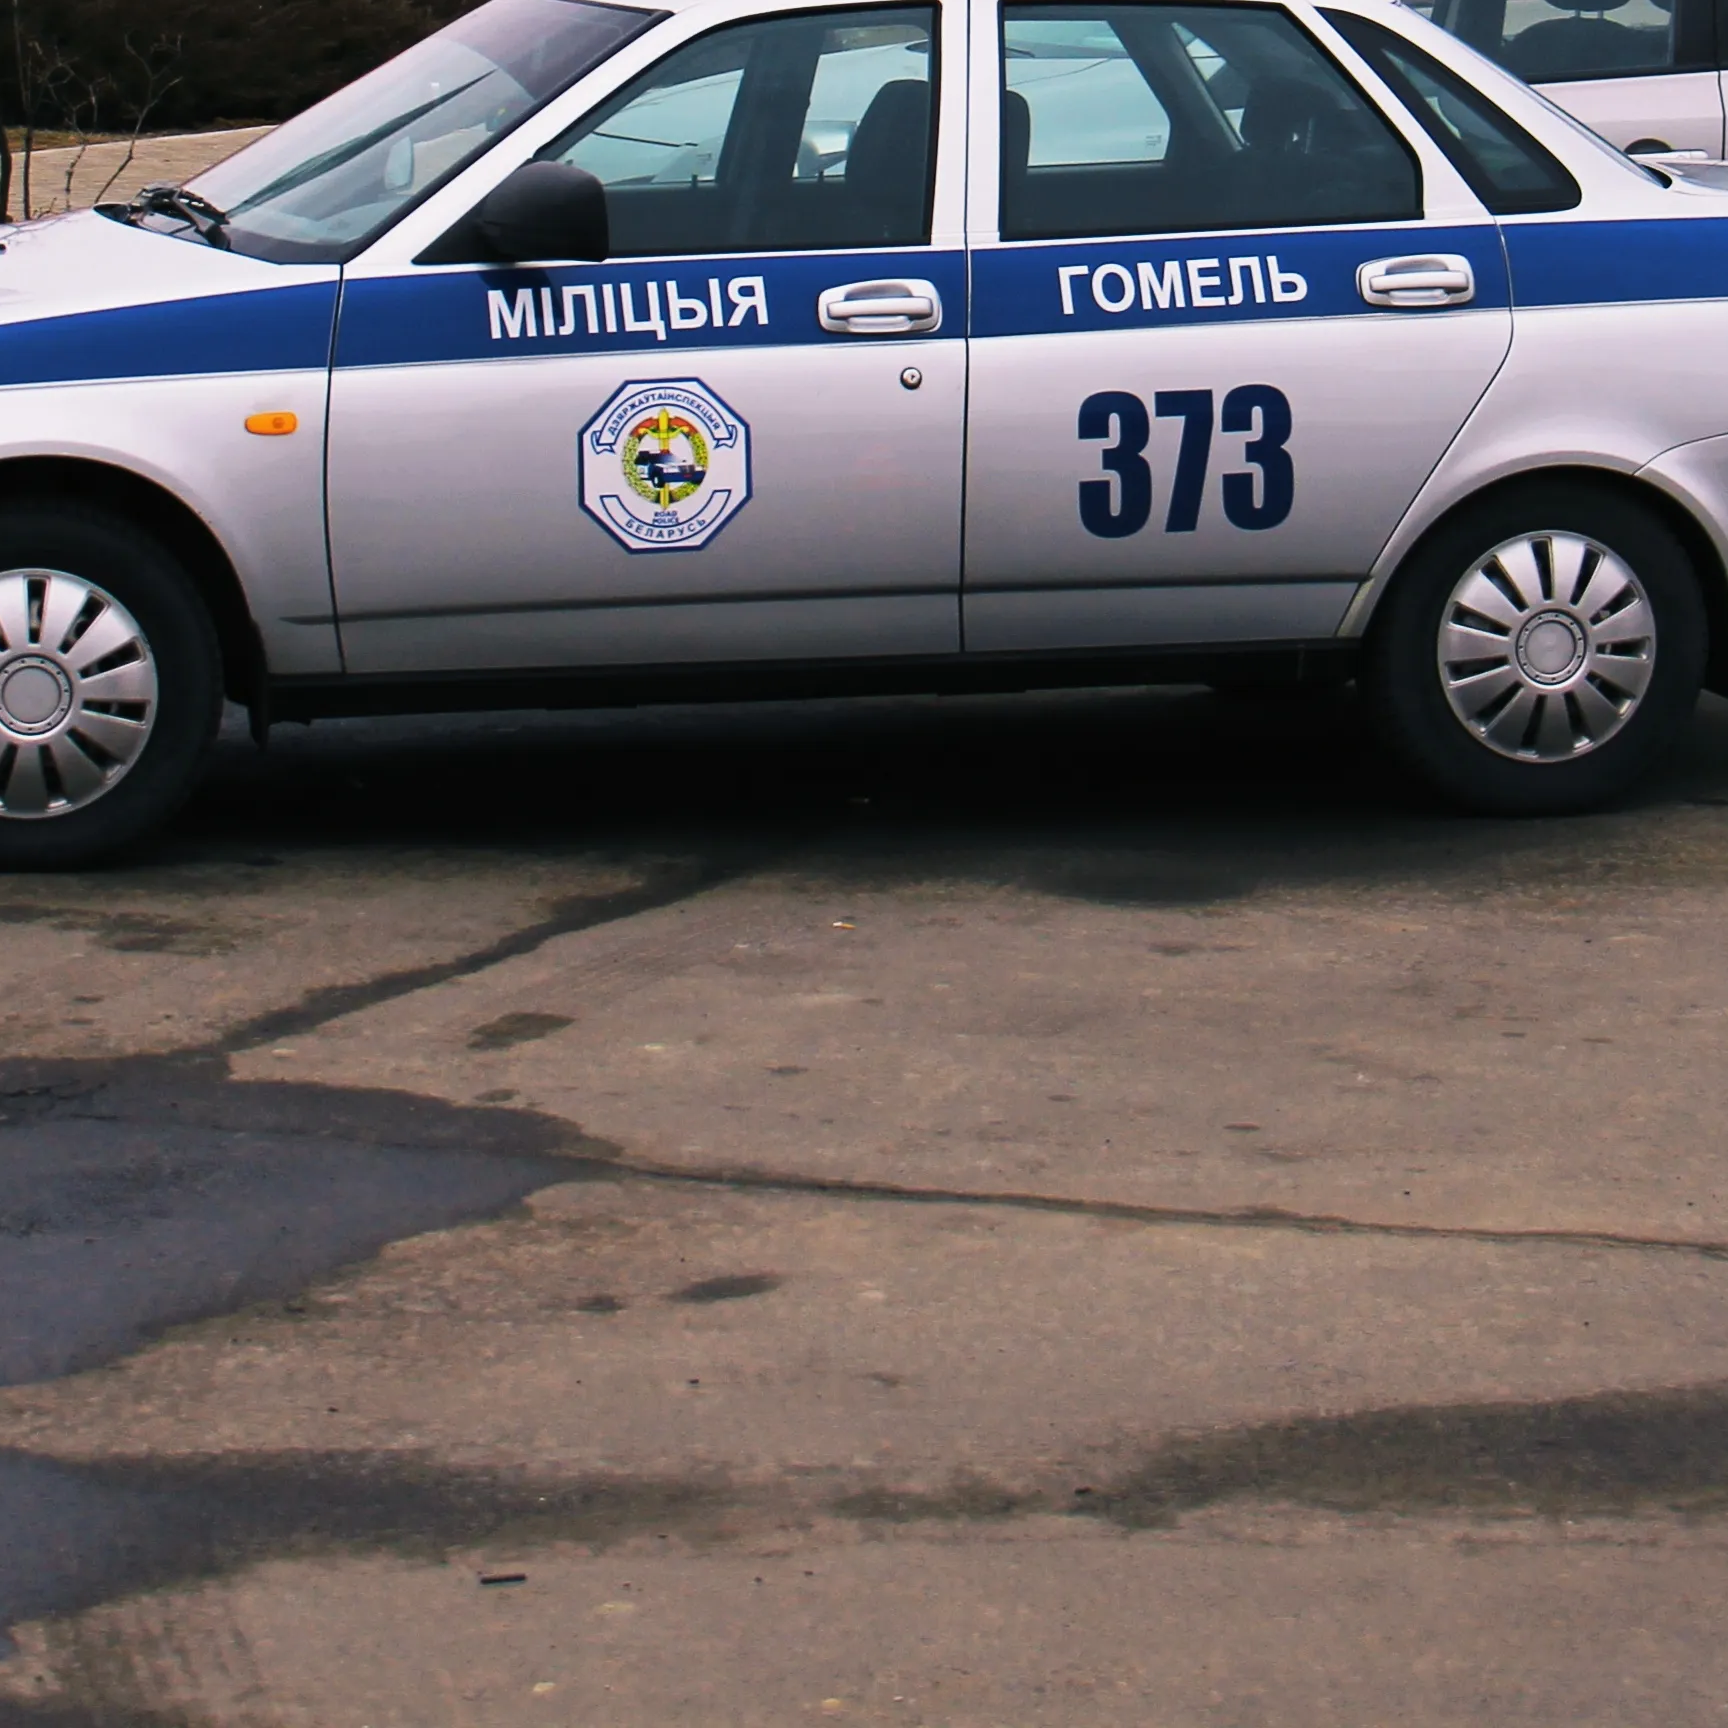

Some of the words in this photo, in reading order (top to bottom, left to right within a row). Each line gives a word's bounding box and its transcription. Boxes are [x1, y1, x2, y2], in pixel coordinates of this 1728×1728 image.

[487, 275, 769, 341] МІЛІЦЫЯ
[1057, 255, 1308, 315] ГОМЕЛЬ
[1077, 383, 1295, 539] 373
[625, 518, 706, 539] БЕЛАРУСЬ
